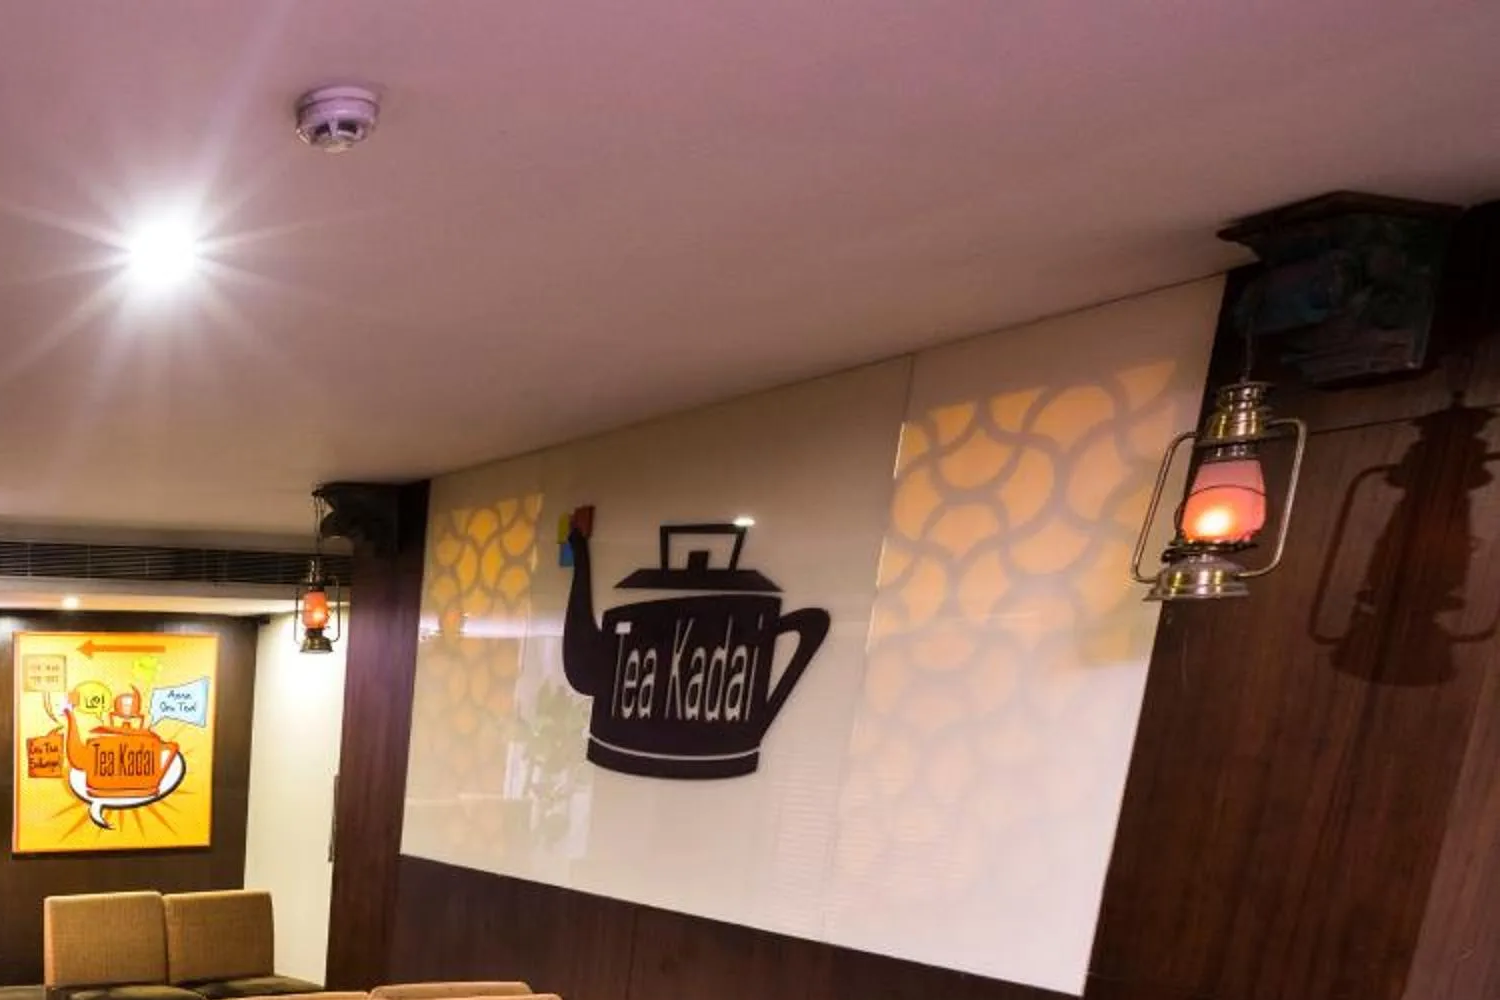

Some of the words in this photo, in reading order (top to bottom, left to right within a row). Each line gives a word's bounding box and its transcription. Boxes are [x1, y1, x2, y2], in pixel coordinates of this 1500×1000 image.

[611, 621, 657, 719] Tea
[665, 614, 764, 722] Kadai
[92, 743, 115, 777] Tea
[119, 743, 155, 777] Kadai
